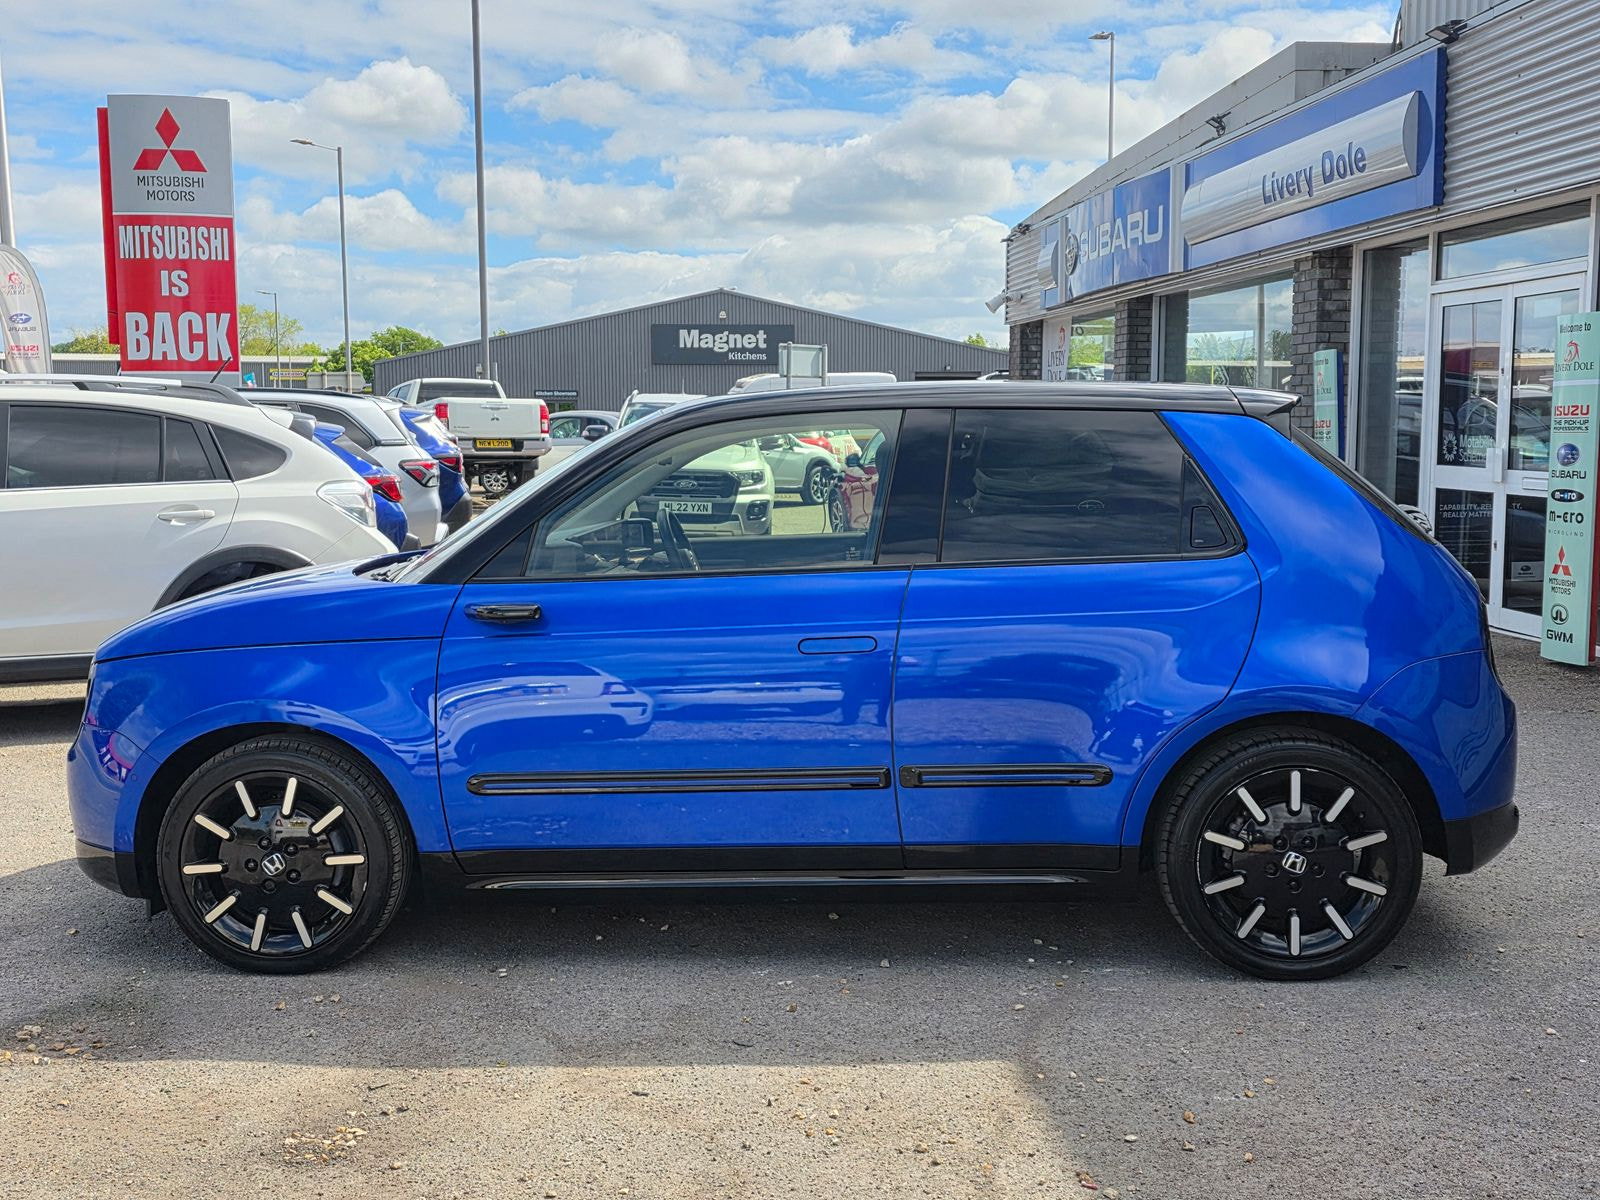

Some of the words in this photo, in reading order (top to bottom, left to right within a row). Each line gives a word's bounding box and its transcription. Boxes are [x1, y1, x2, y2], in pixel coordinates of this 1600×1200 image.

[1262, 165, 1313, 205] Livery
[1321, 141, 1367, 184] Dole
[137, 175, 205, 188] MITSUBISHI
[147, 190, 195, 202] MOTORS
[1079, 205, 1164, 265] SUBARU
[119, 225, 230, 260] MITSUBISHI
[160, 269, 189, 297] IS
[1584, 321, 1592, 331] to
[125, 311, 233, 362] BACK
[679, 329, 767, 352] Magnet
[728, 351, 767, 360] Kitchens
[1555, 362, 1573, 372] LIVERY
[1573, 361, 1595, 371] DOLE
[1554, 404, 1590, 416] ISUZU
[1459, 448, 1487, 462] Schem
[1551, 469, 1587, 479] SUBARU
[690, 503, 709, 512] YXN
[1468, 511, 1493, 519] MATTE
[1548, 577, 1577, 588] MITSUBISHI
[1550, 586, 1572, 595] MOTORS
[1546, 629, 1574, 643] GWM
